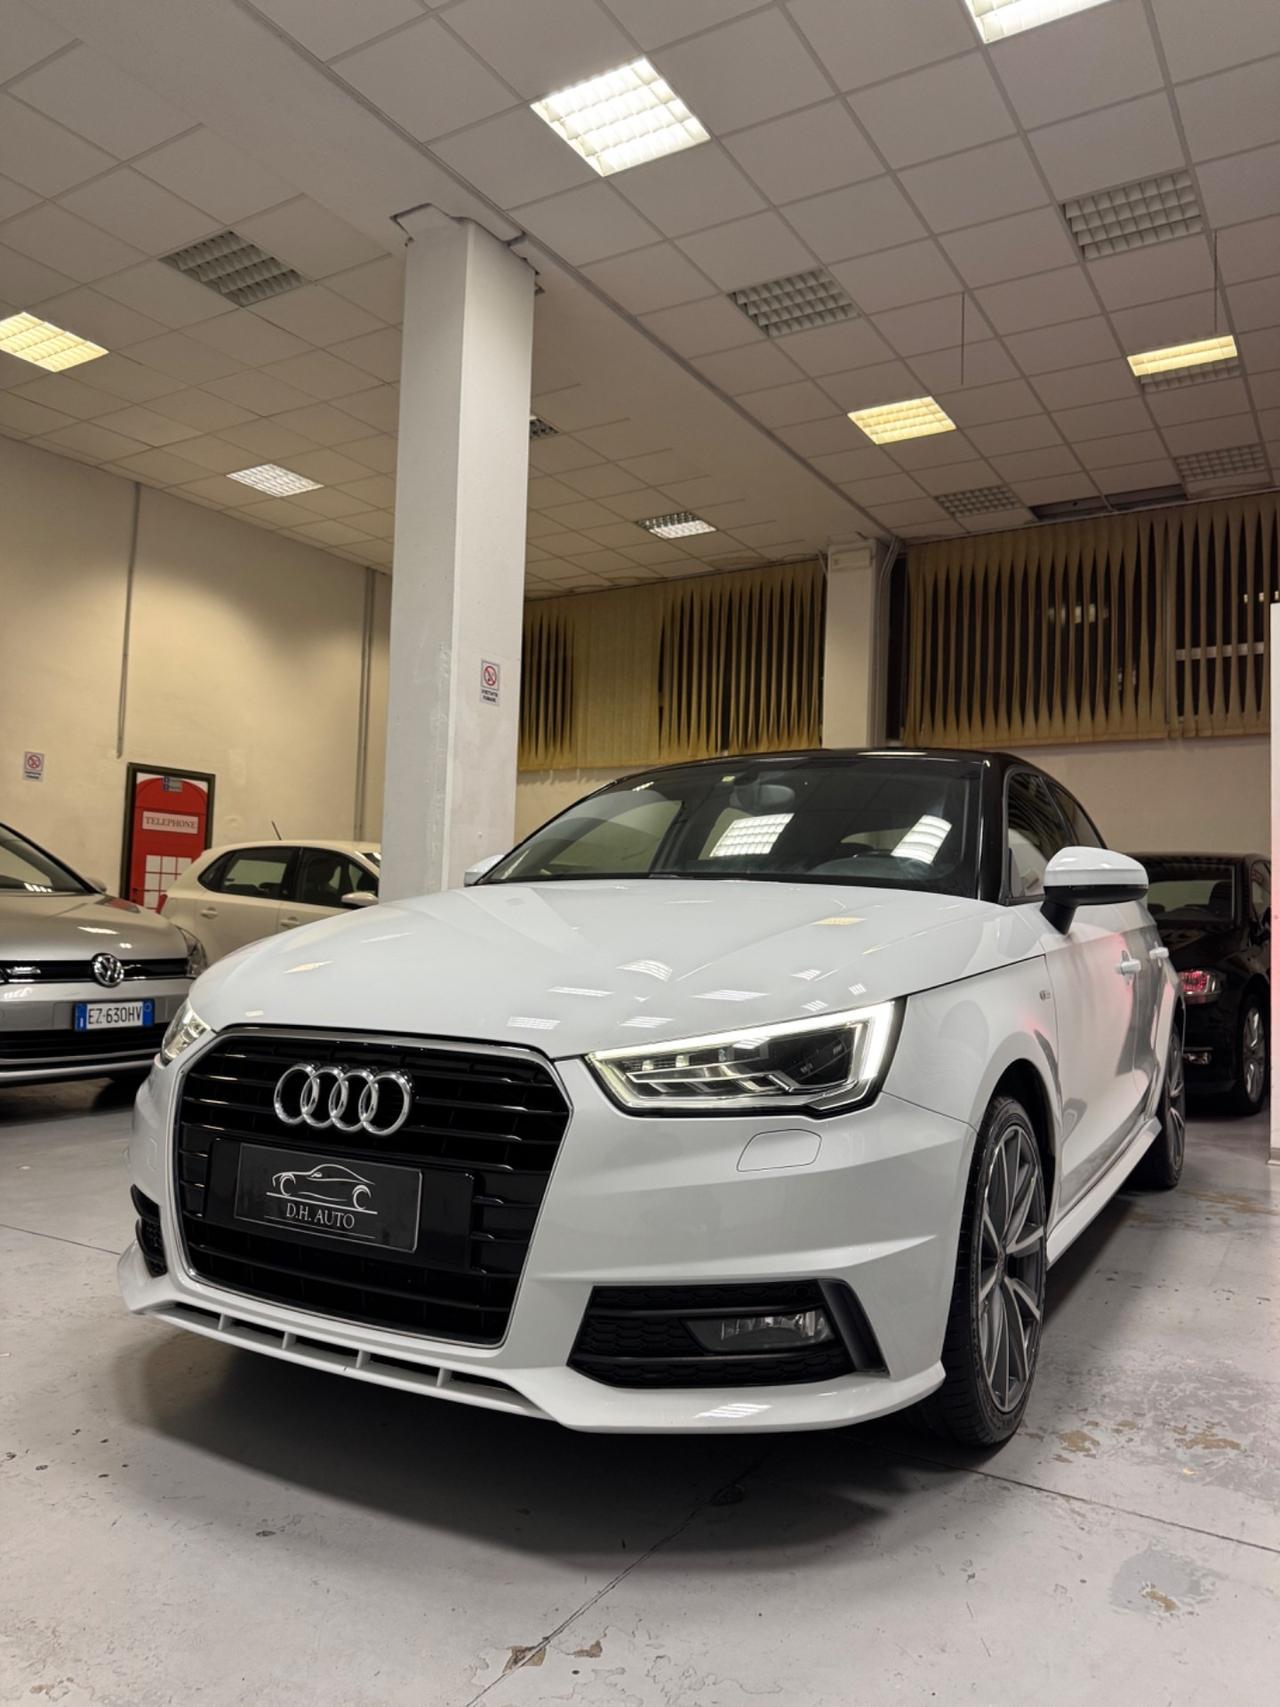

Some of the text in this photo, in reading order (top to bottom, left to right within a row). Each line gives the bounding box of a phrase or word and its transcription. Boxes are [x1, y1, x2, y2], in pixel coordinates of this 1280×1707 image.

[144, 816, 197, 829] TELEPHONE
[287, 1203, 355, 1229] D.H. AUTO
